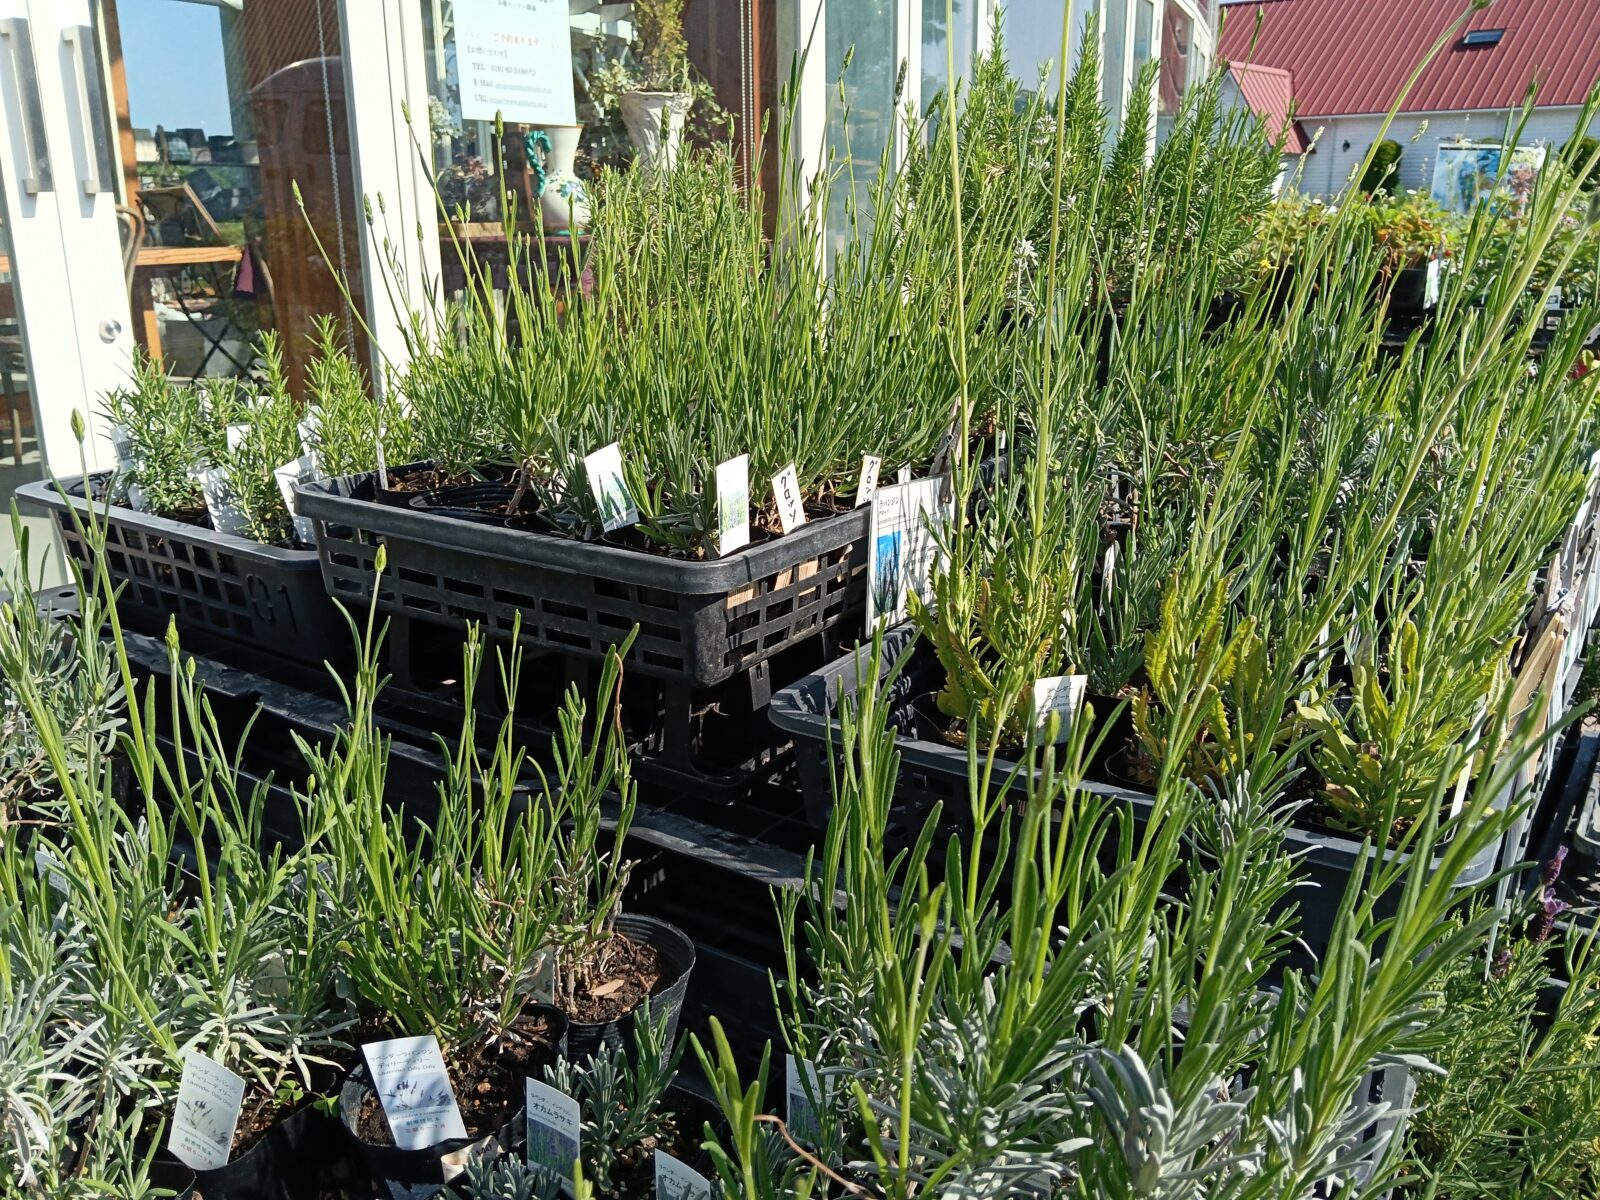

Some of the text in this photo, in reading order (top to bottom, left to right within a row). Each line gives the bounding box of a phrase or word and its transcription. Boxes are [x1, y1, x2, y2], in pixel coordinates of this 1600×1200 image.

[533, 1102, 573, 1126] オカムラサキ
